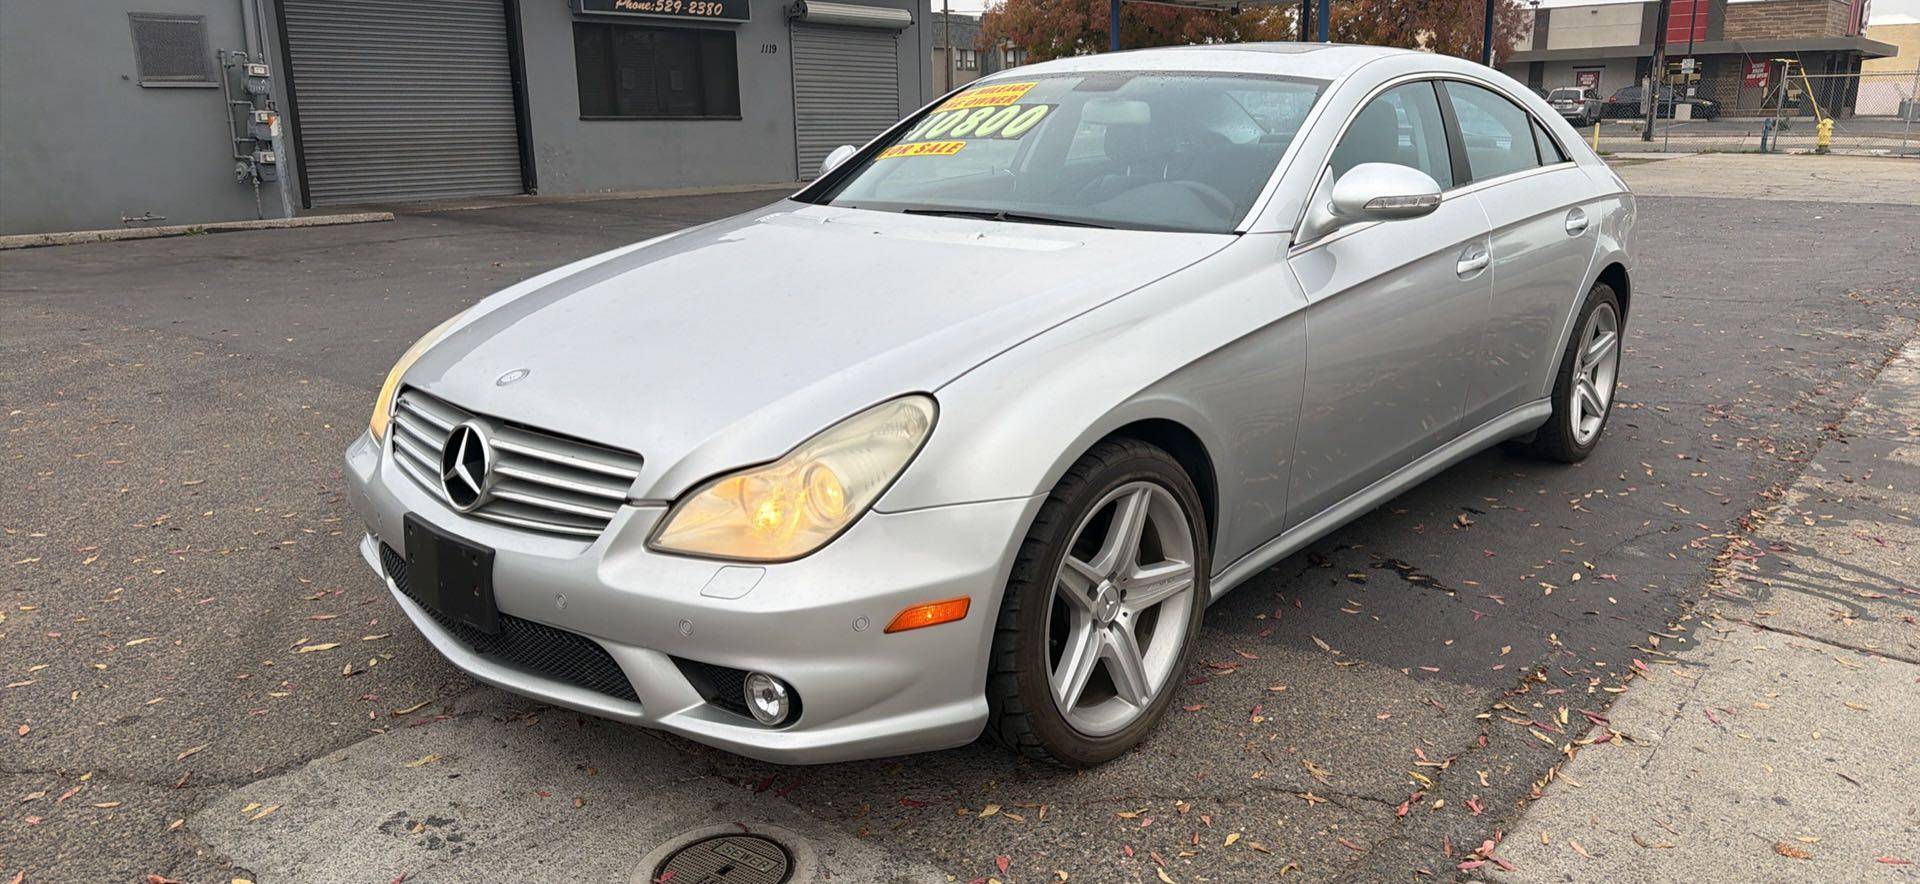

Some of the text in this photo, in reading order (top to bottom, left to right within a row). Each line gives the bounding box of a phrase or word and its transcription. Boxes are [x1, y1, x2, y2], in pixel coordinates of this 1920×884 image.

[761, 44, 776, 53] 1119
[914, 142, 964, 154] SALE
[723, 846, 770, 868] SEWER
